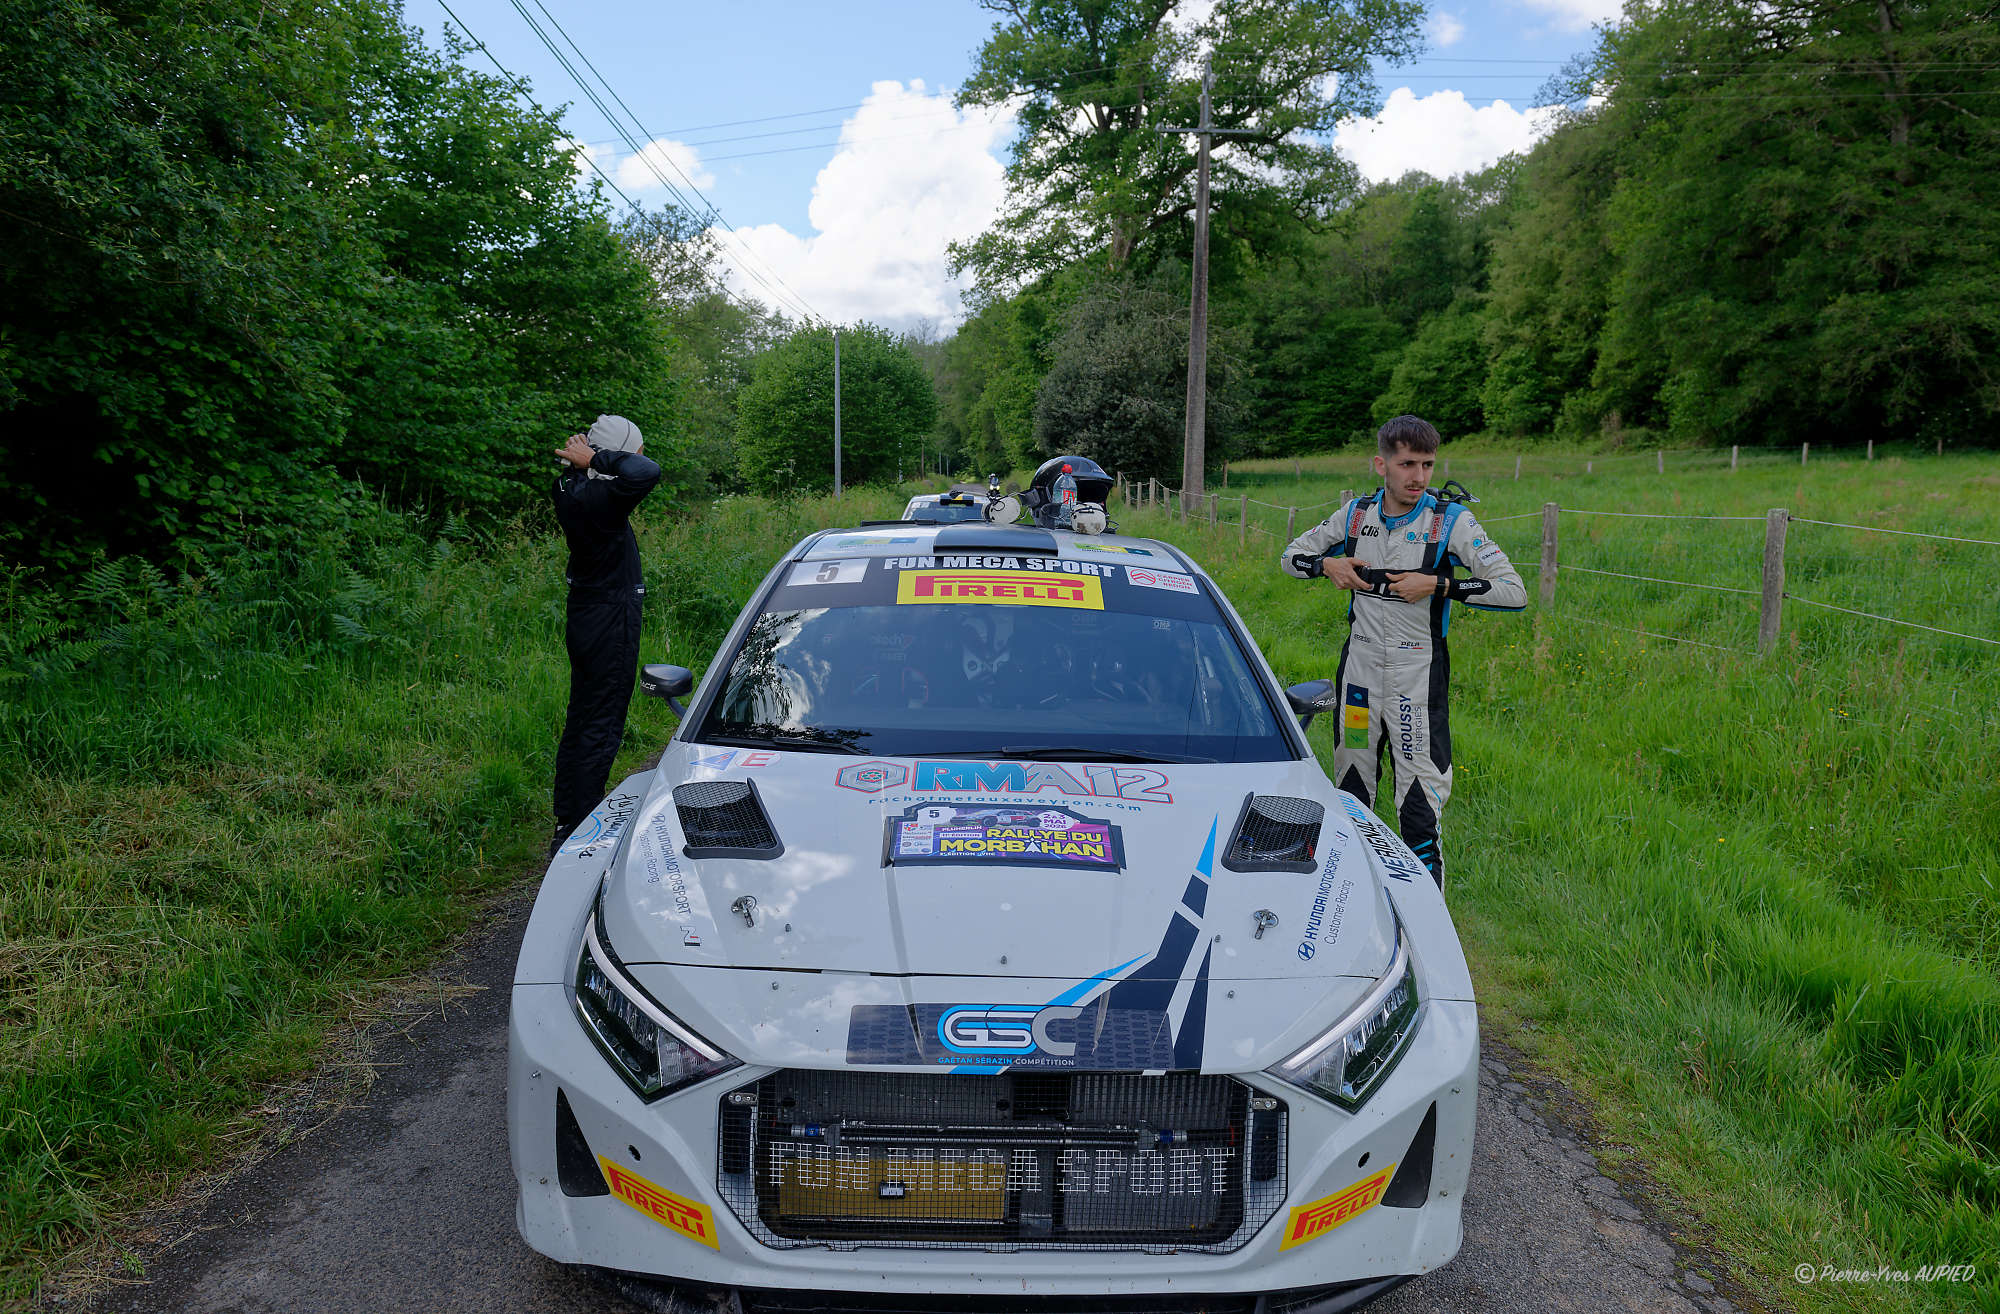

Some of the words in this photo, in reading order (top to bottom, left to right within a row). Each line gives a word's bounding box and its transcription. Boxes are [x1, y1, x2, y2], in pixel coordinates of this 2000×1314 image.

[816, 562, 840, 583] 5
[883, 556, 937, 569] FUN
[943, 556, 1023, 570] MECA
[1027, 557, 1115, 577] SPORT
[915, 575, 1085, 601] PIRELLI
[1400, 694, 1412, 761] BROUSSY
[1415, 706, 1423, 752] ENERGIES
[912, 760, 1174, 804] RMA12
[929, 809, 940, 818] 5
[986, 828, 1068, 841] RALLYE
[1071, 831, 1103, 843] DU
[1324, 902, 1345, 945] Customer
[1336, 879, 1354, 906] Racing
[937, 1004, 1084, 1056] GSC
[975, 1056, 1013, 1065] SÉRAZIN
[1015, 1057, 1075, 1066] COMPÉTITION
[608, 1166, 706, 1238] PIRELLI
[1292, 1175, 1387, 1241] PIRELLI
